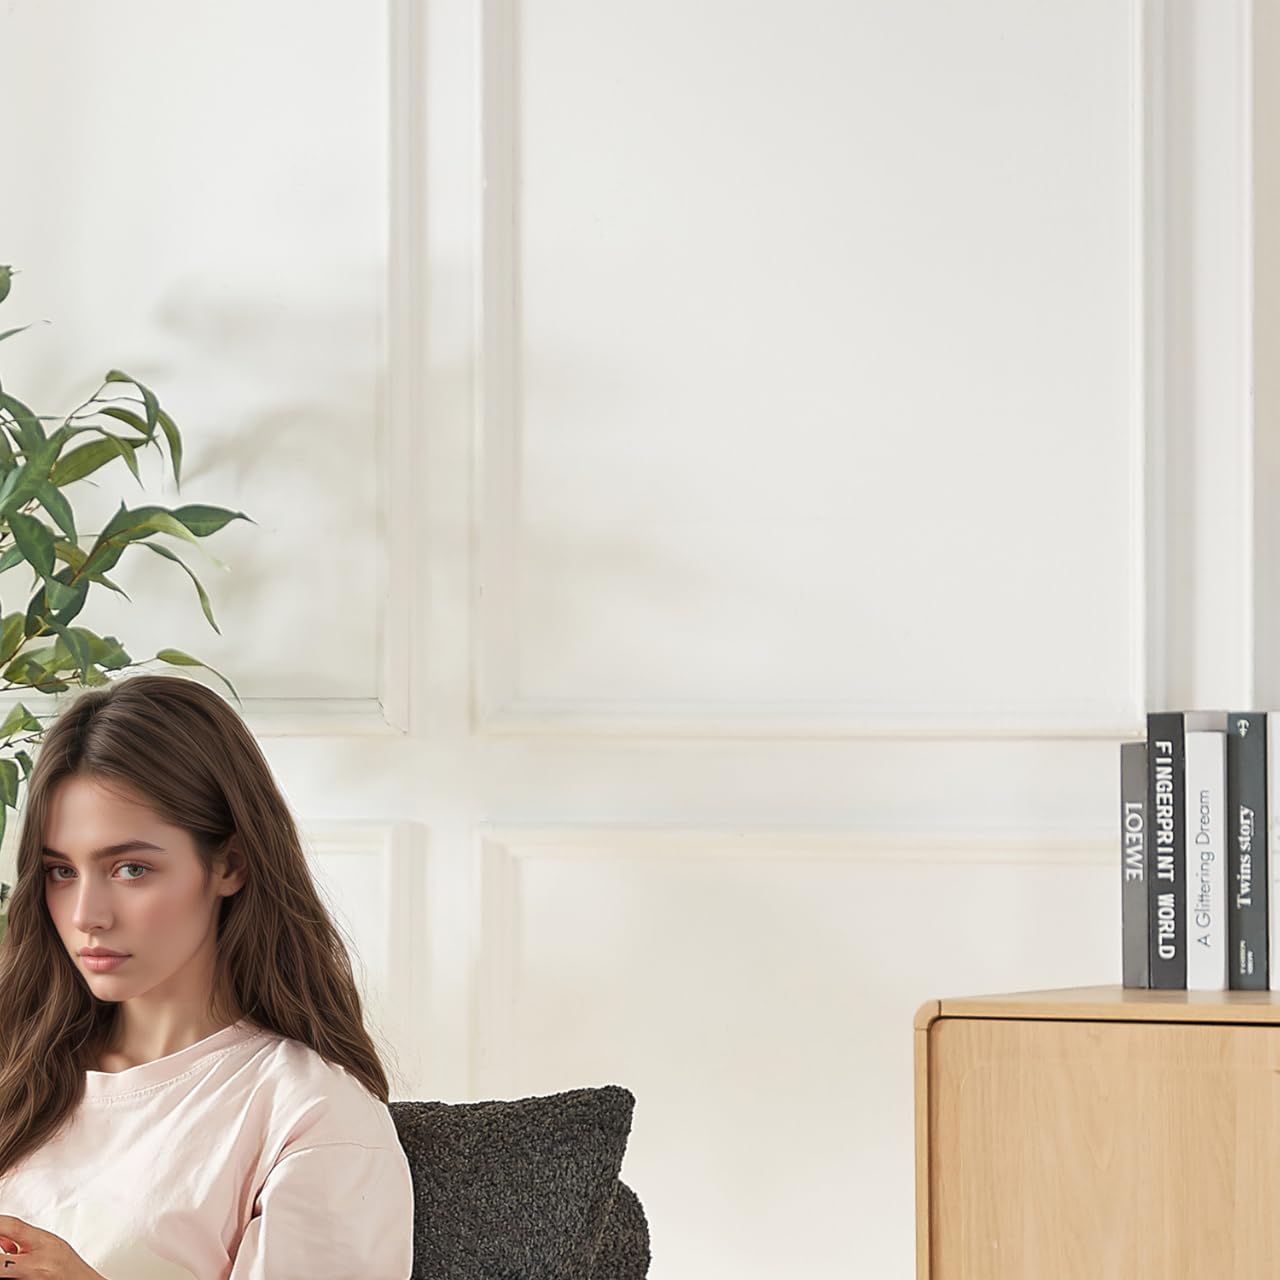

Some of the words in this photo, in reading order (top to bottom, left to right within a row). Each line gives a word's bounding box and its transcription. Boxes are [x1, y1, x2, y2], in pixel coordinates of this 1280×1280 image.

[1125, 801, 1144, 882] LOEWE
[1155, 741, 1175, 882] FINGERPRINT
[1196, 789, 1210, 845] Dream
[1237, 804, 1255, 852] story
[1196, 850, 1215, 928] Glittering
[1236, 854, 1252, 910] Twins
[1157, 893, 1176, 959] WORLD
[1197, 935, 1211, 948] A
